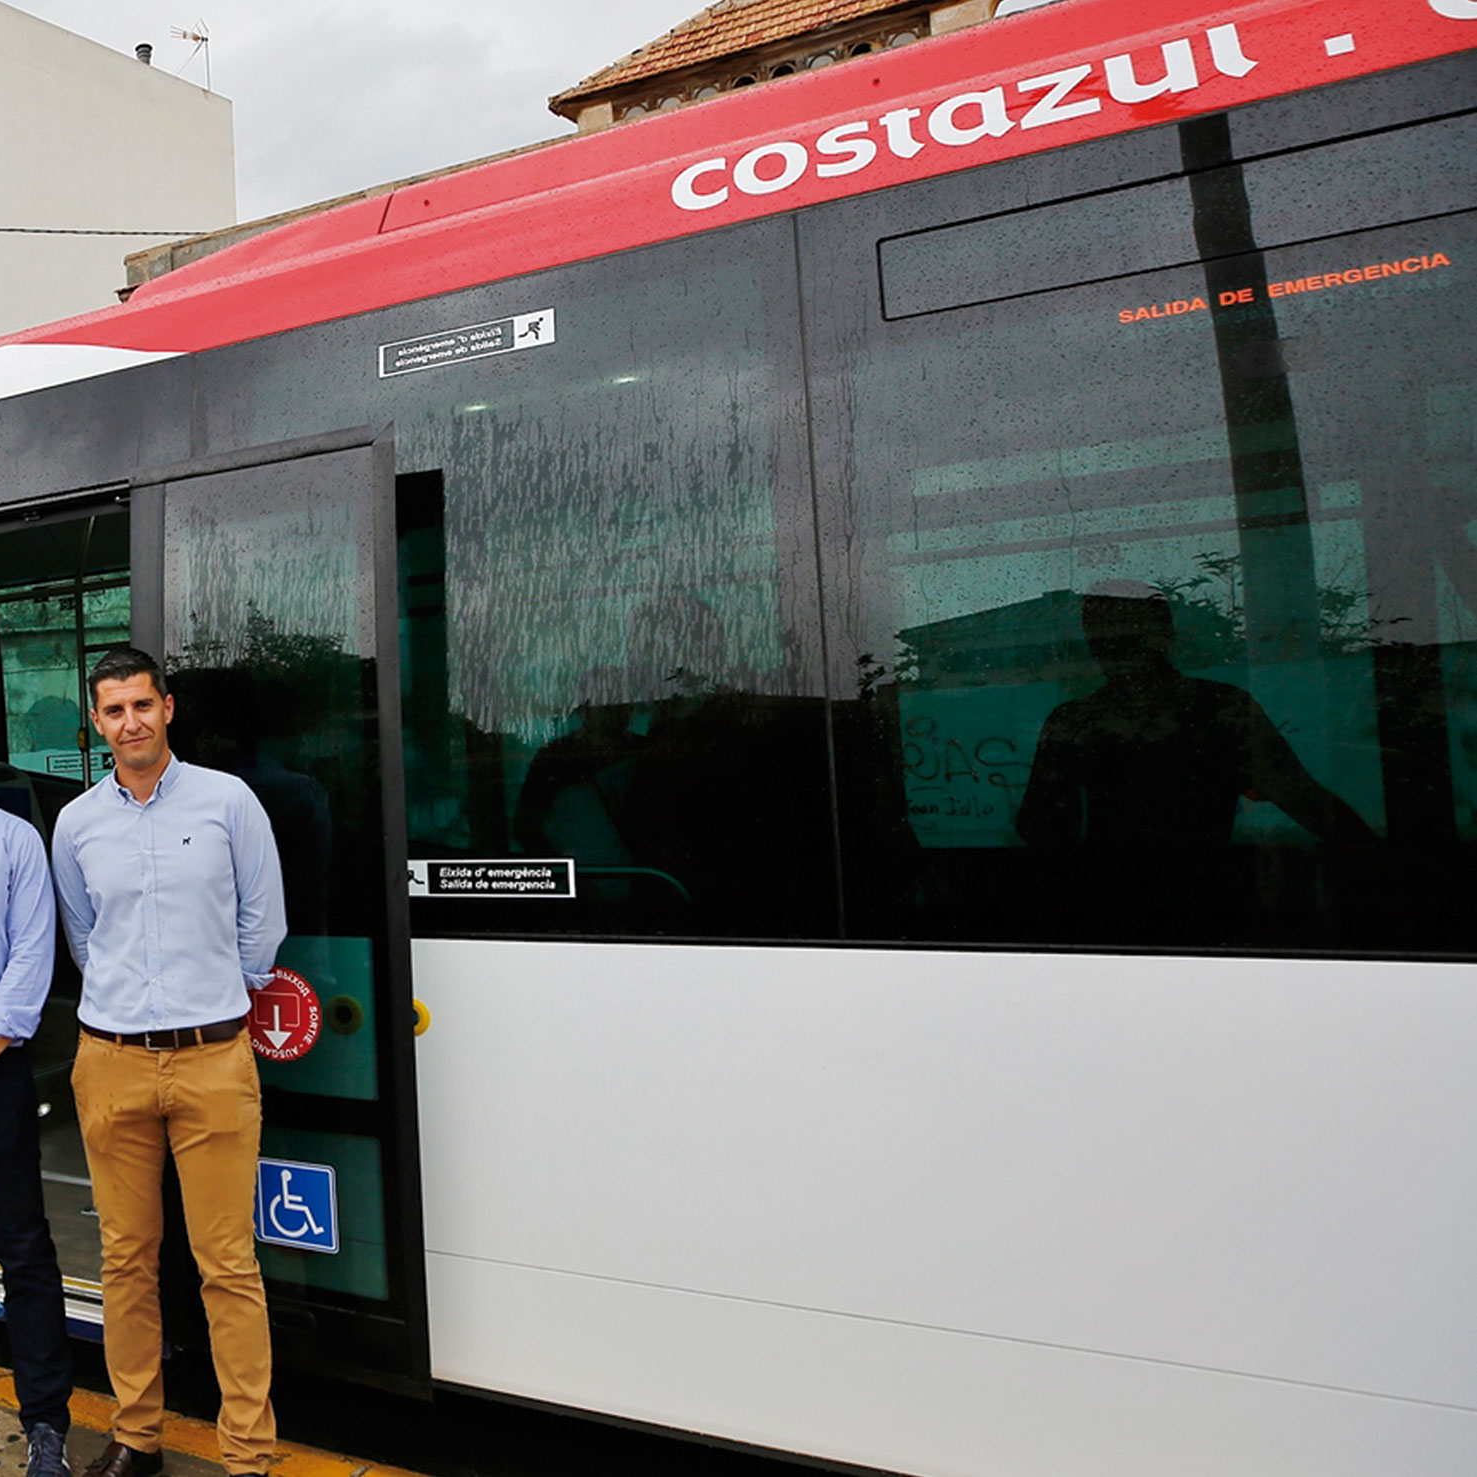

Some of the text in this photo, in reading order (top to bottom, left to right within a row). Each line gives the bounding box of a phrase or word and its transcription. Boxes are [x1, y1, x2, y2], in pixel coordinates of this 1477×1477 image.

[671, 23, 1259, 211] costazul
[1118, 252, 1452, 324] SALIDA DE EMERGENCIA
[439, 867, 473, 878] Eixida
[439, 879, 556, 891] Salida de emergencia
[303, 1005, 319, 1045] SORTIE
[251, 1038, 300, 1060] AUSGANG
